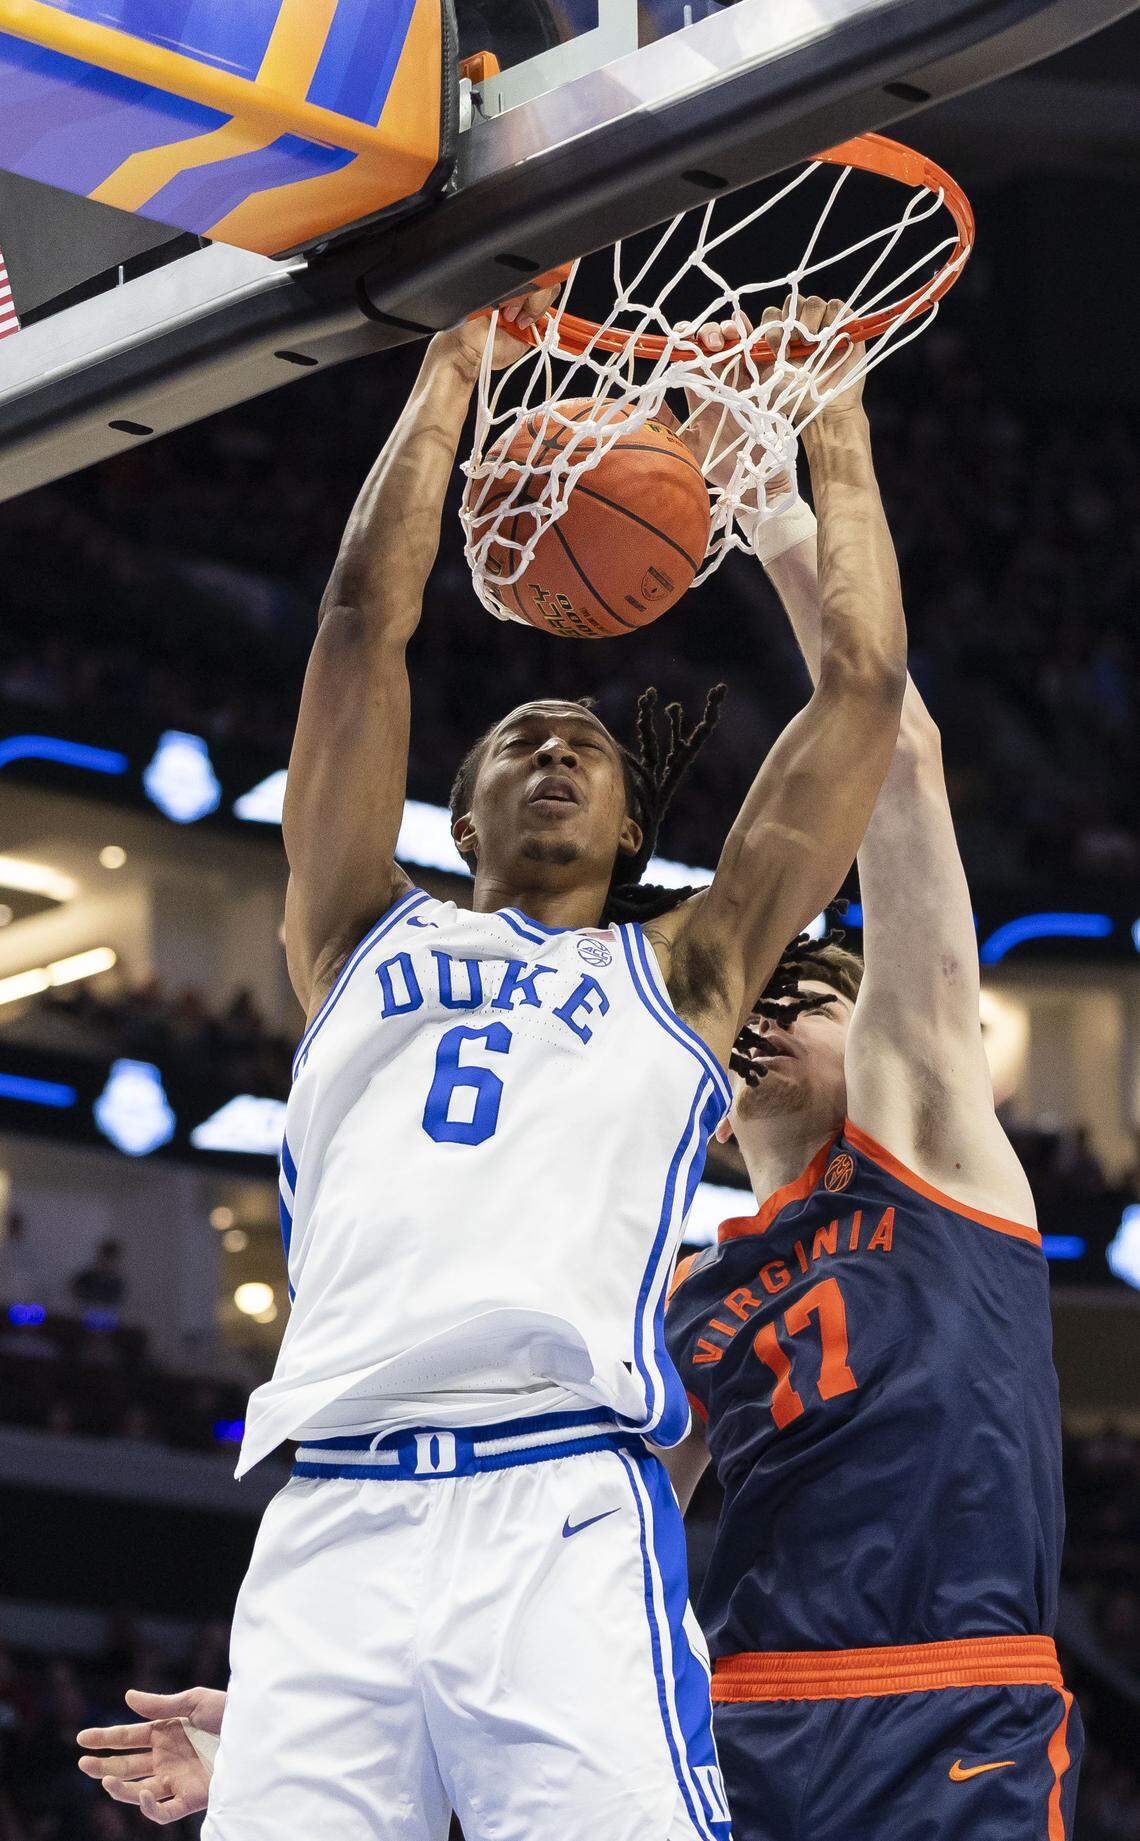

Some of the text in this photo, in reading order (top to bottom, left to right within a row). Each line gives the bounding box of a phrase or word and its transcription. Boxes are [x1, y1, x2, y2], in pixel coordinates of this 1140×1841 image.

[375, 950, 610, 1045] DUKE
[422, 1021, 514, 1147] 6
[692, 1207, 895, 1364] VIRGINIA
[754, 1277, 858, 1430] 17
[414, 1431, 456, 1474] D
